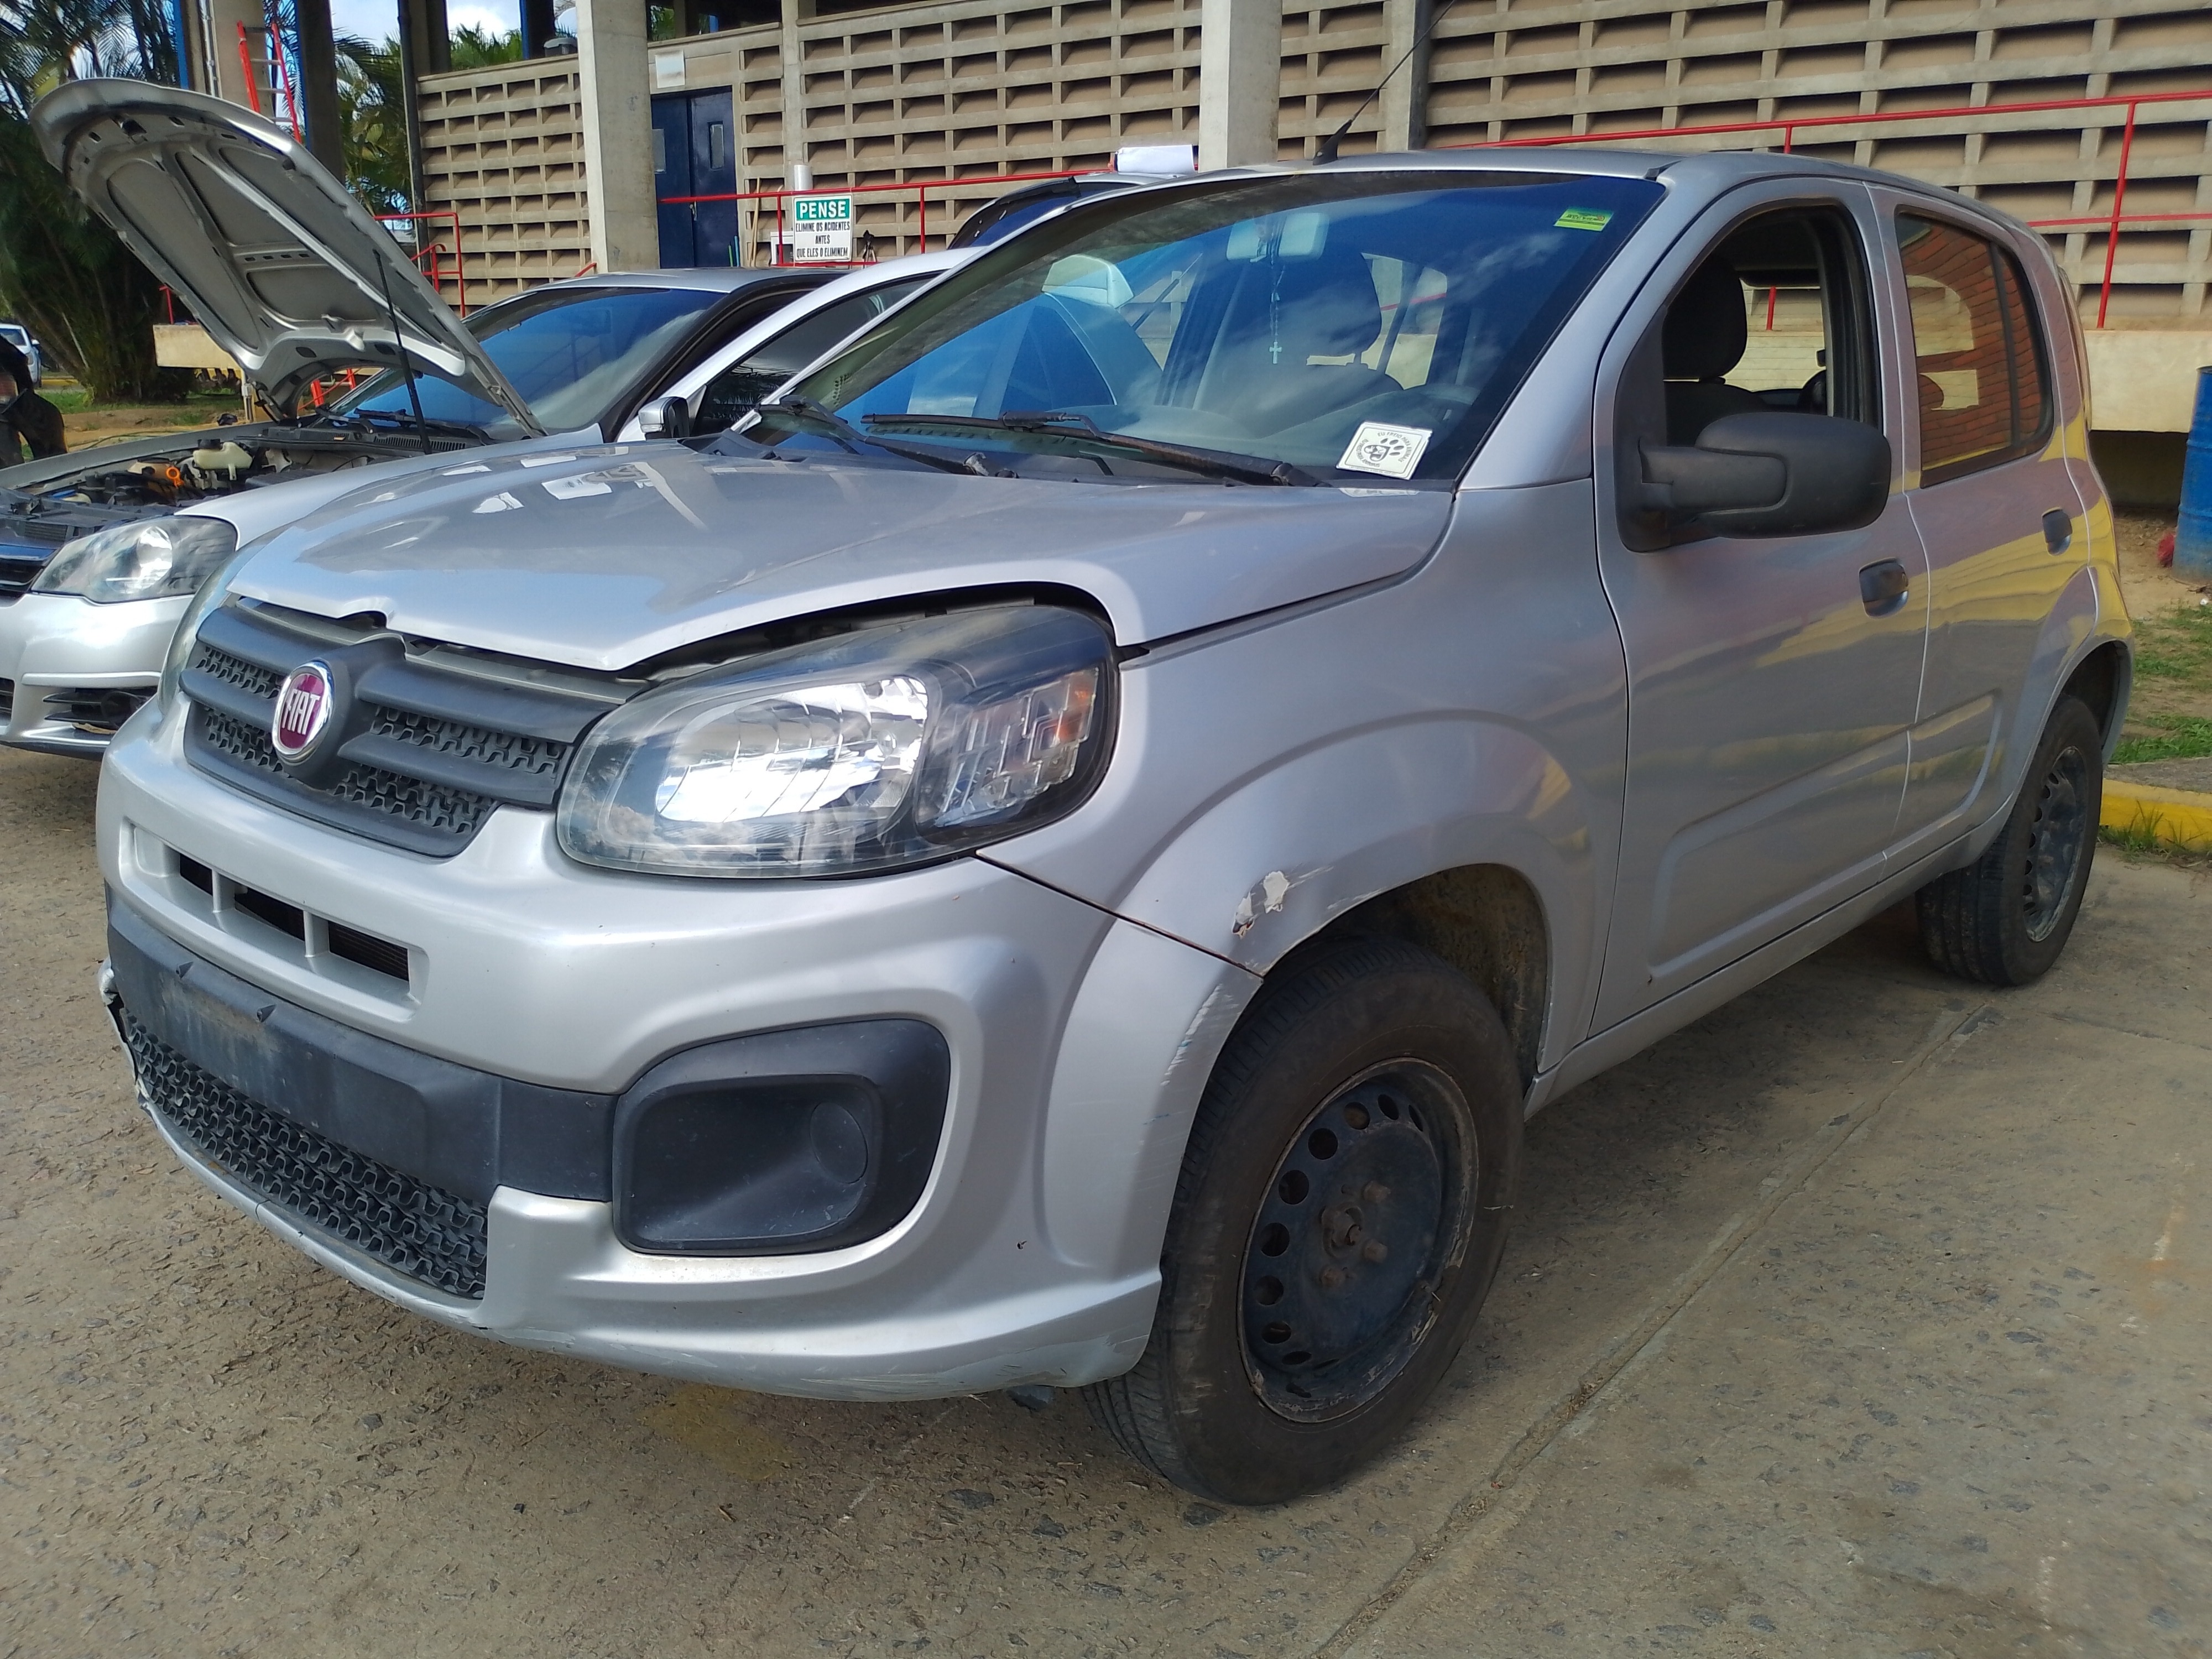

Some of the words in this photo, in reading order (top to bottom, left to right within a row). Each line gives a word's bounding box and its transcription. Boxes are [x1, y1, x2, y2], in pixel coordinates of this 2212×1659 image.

[800, 201, 846, 218] PENSE
[796, 222, 815, 232] ELIMINE
[816, 222, 823, 232] OS
[824, 221, 850, 231] ACIDENTES
[815, 234, 830, 244] ANTES
[796, 248, 806, 259] QUE
[807, 248, 818, 257] ELES
[820, 248, 823, 257] O
[825, 247, 848, 257] ELIMINEM
[281, 688, 321, 735] FIAT
